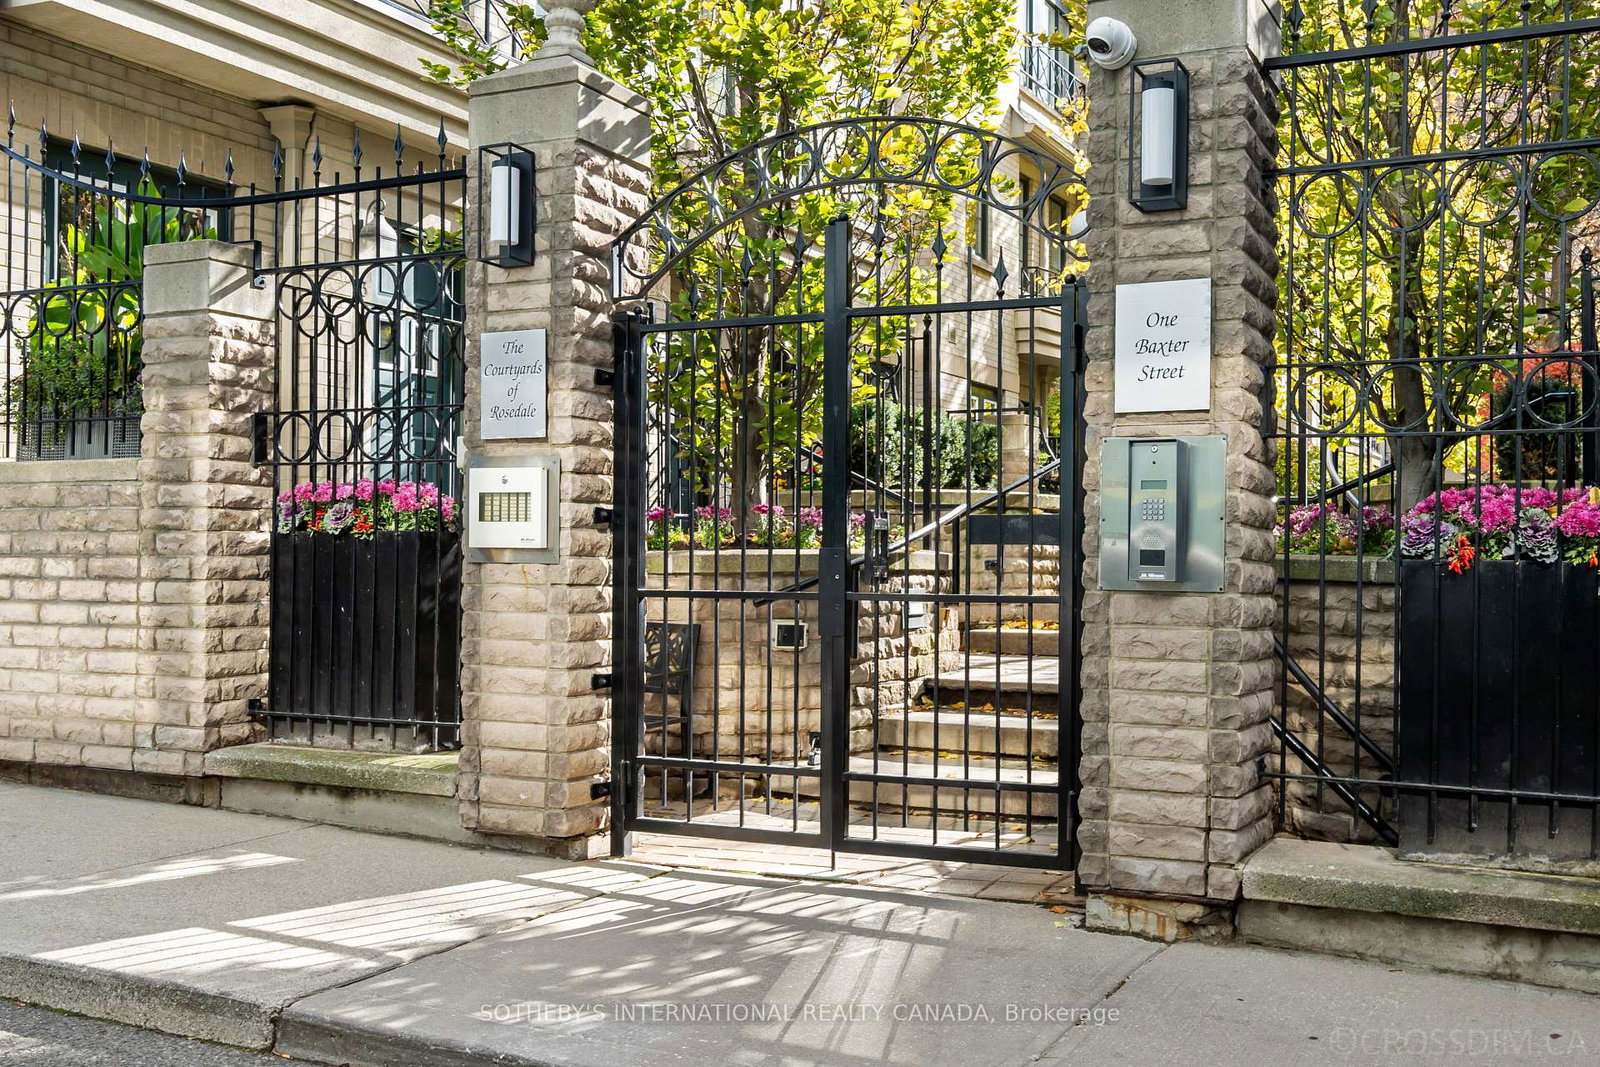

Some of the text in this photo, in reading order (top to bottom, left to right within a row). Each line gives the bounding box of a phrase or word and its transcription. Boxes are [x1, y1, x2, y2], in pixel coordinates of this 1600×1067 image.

[1146, 312, 1179, 328] One
[502, 339, 524, 354] The
[1134, 338, 1191, 358] Baxter
[484, 360, 543, 381] Courtyards
[1137, 364, 1186, 382] Street
[506, 382, 521, 403] of
[490, 403, 536, 420] Rosedale
